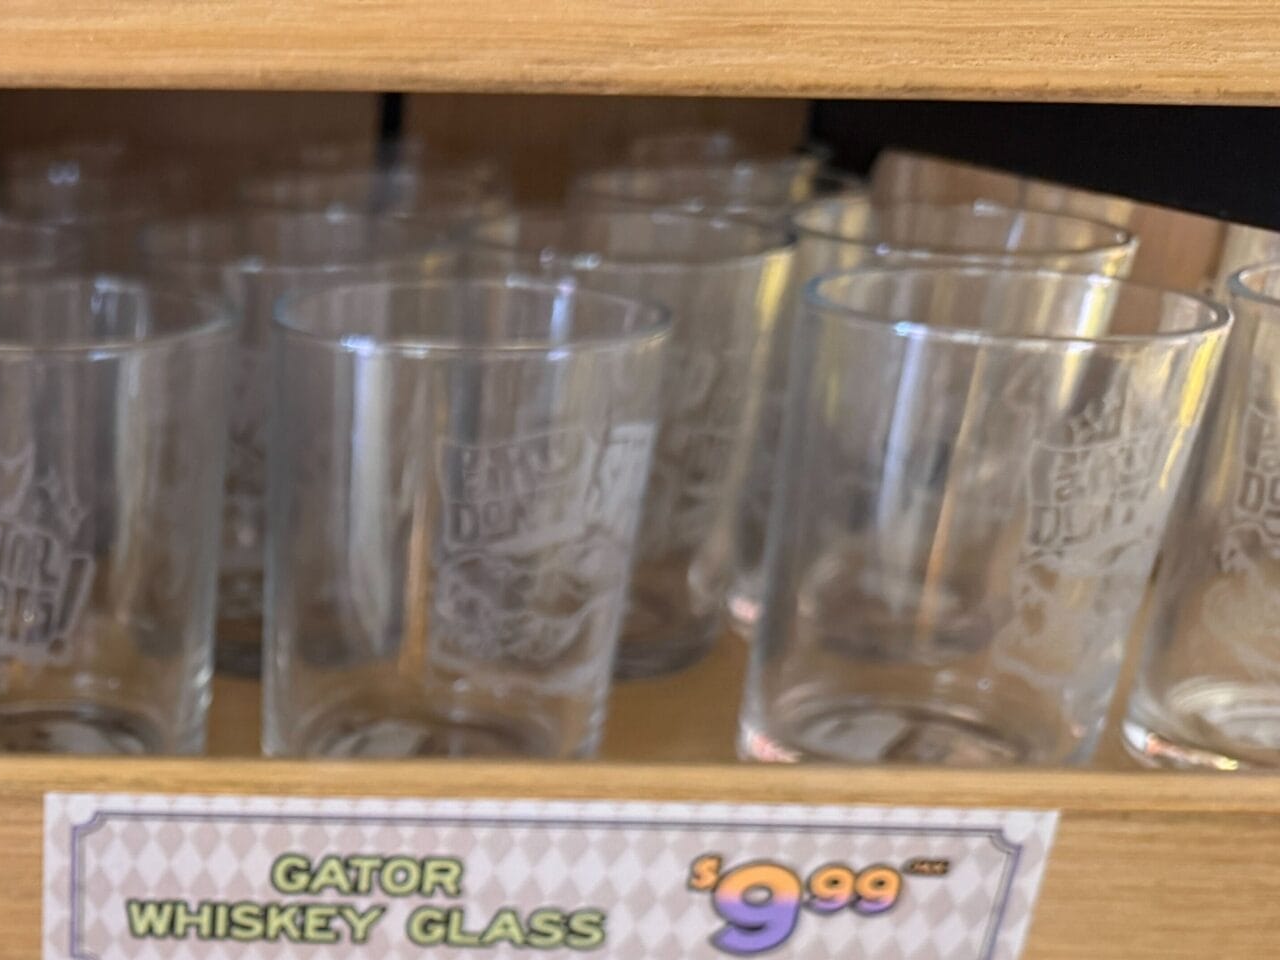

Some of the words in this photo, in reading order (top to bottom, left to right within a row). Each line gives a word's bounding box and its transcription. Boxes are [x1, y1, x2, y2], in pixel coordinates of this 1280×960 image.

[270, 853, 464, 896] GATOR
[126, 899, 387, 944] WHISKEY
[405, 905, 607, 950] GLASS
